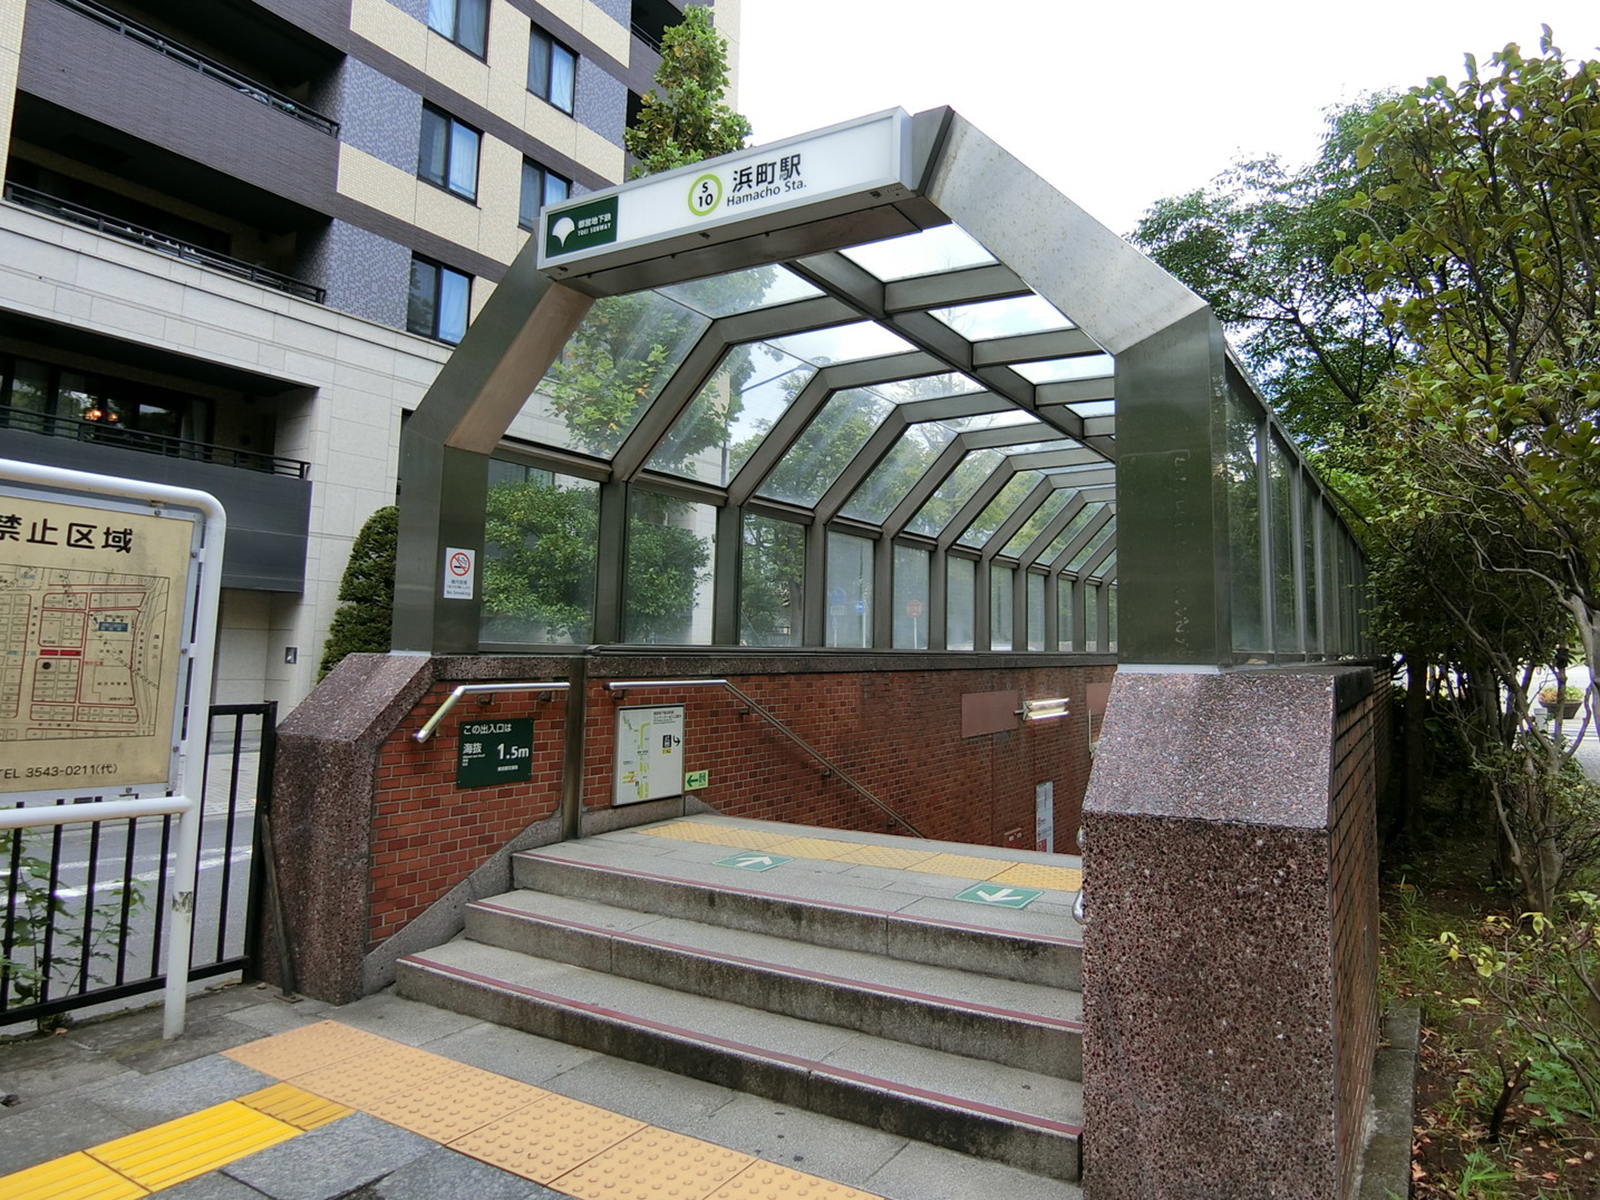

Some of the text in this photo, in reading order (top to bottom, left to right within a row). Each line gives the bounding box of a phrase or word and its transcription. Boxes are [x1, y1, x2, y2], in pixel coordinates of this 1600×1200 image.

[732, 153, 801, 193] 浜町駅
[702, 181, 709, 194] S
[726, 179, 807, 207] Hamacho Sta.
[698, 193, 714, 208] 10
[463, 723, 513, 735] この出入口は
[462, 742, 483, 754] 海抜
[497, 743, 530, 760] 1.5m
[25, 763, 118, 778] 3543-0211(代)
